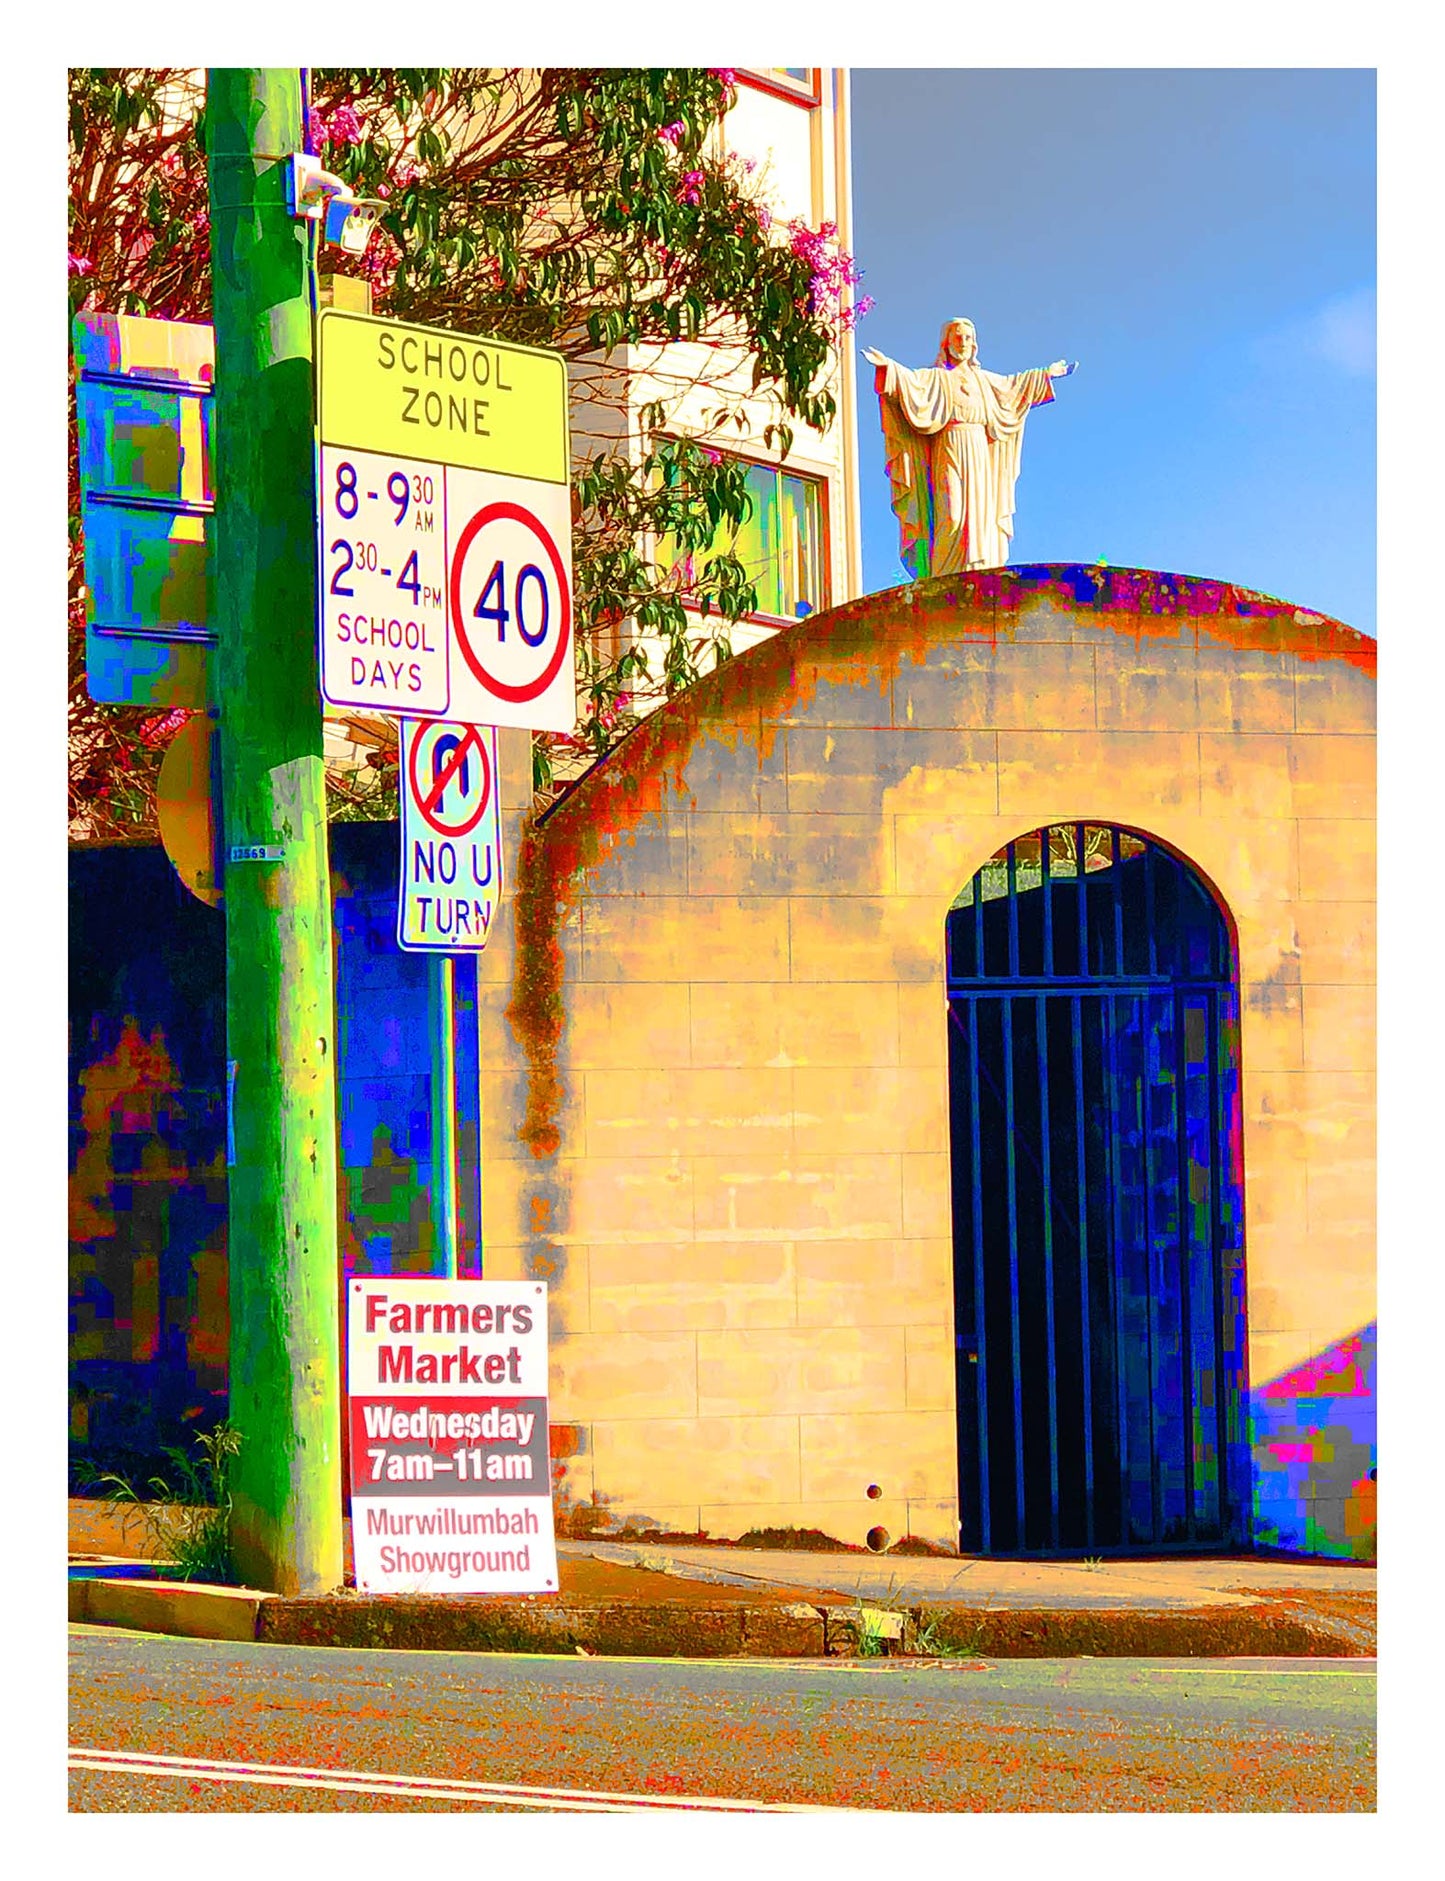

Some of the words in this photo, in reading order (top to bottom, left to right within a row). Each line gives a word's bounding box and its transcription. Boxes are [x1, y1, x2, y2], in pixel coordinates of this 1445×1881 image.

[378, 333, 512, 391] SCHOOL
[401, 386, 490, 436] ZONE
[415, 510, 434, 533] AM
[423, 586, 442, 609] PM
[473, 560, 549, 647] 40
[337, 613, 435, 652] SCHOOL
[351, 657, 422, 692] DAYS
[414, 840, 457, 885] NO
[472, 844, 492, 887] U
[416, 897, 491, 935] TURN
[365, 1295, 533, 1334] Farmers
[378, 1346, 522, 1384] Market
[362, 1406, 535, 1445] Wednesday
[367, 1508, 539, 1536] Murwillumbah
[380, 1545, 530, 1578] Showground
